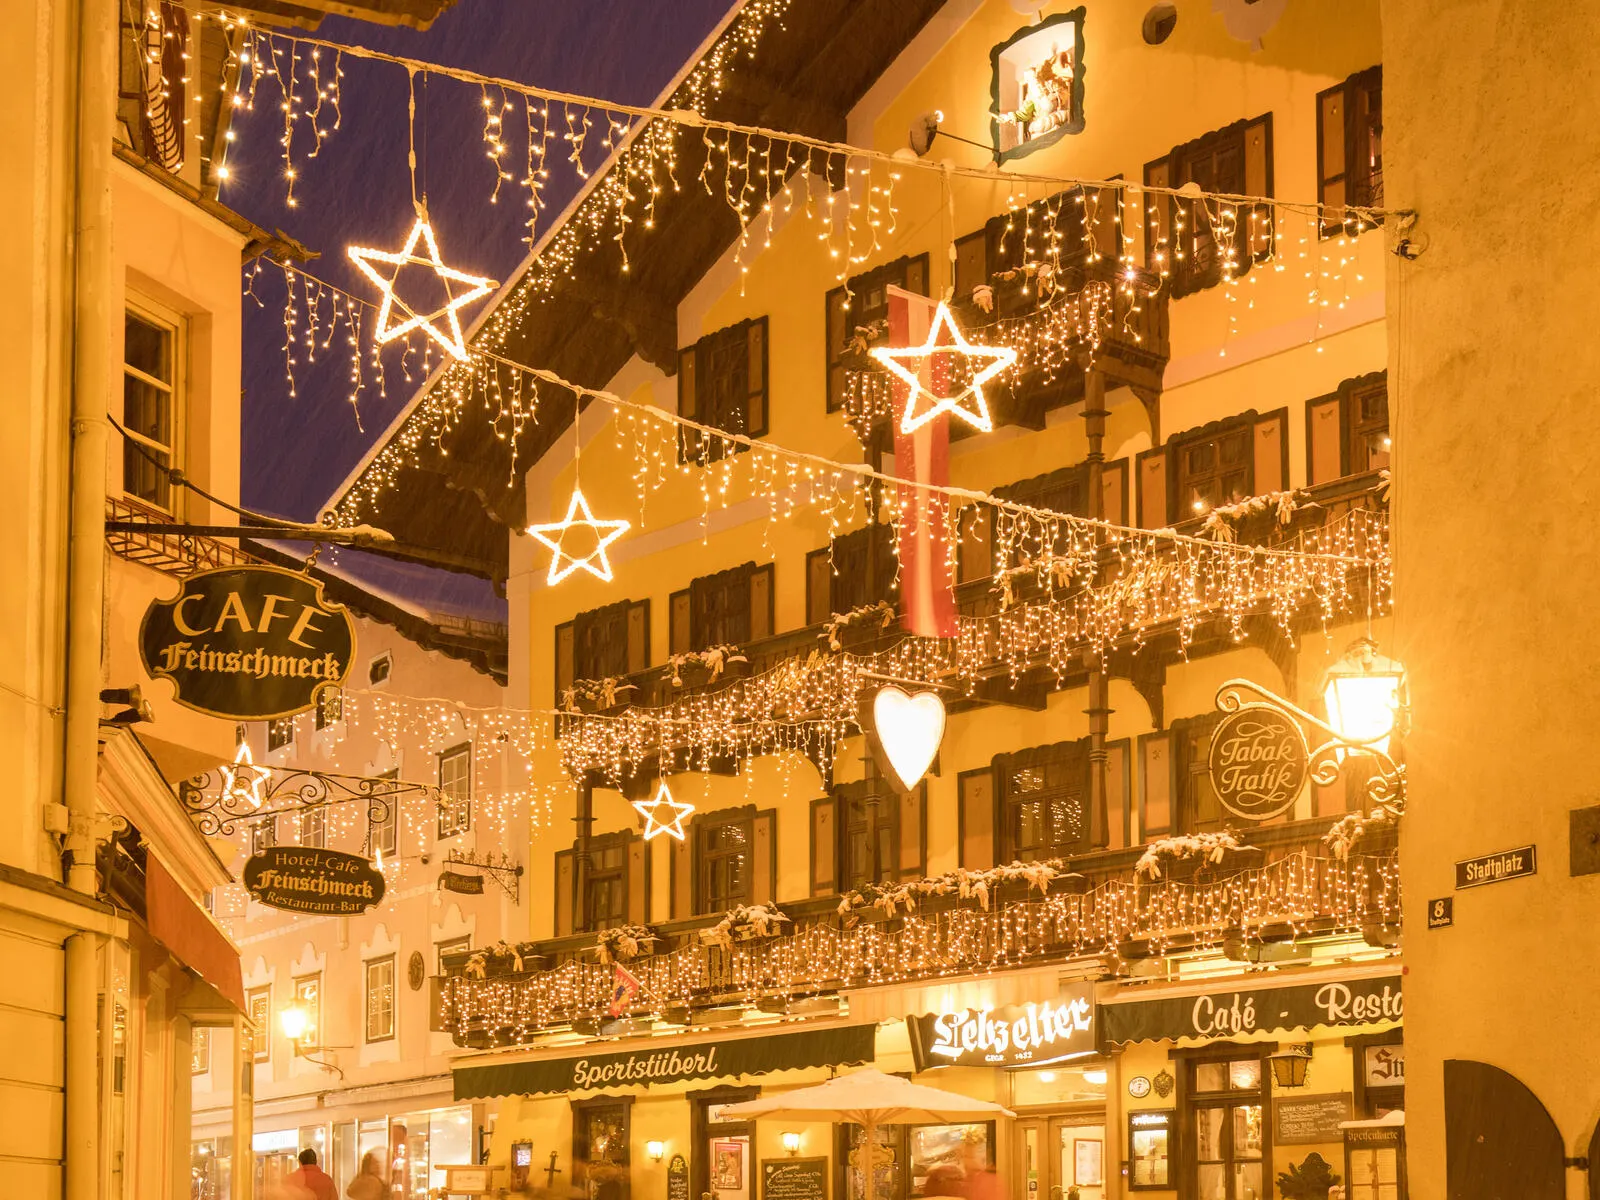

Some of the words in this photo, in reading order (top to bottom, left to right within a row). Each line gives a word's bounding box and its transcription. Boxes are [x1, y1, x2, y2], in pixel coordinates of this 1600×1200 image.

[172, 591, 332, 649] CAFE
[153, 641, 341, 681] Feinschmeck
[1220, 730, 1297, 766] Tabak
[1220, 762, 1297, 799] Trafik
[252, 869, 374, 899] Feinschmeck
[1466, 855, 1523, 880] Stadtplatz
[266, 891, 361, 912] Restaurant-Bar
[1433, 900, 1445, 918] 8
[930, 996, 1092, 1062] Lebzelter
[1192, 993, 1256, 1034] Café
[573, 1046, 718, 1089] Sportstüberl
